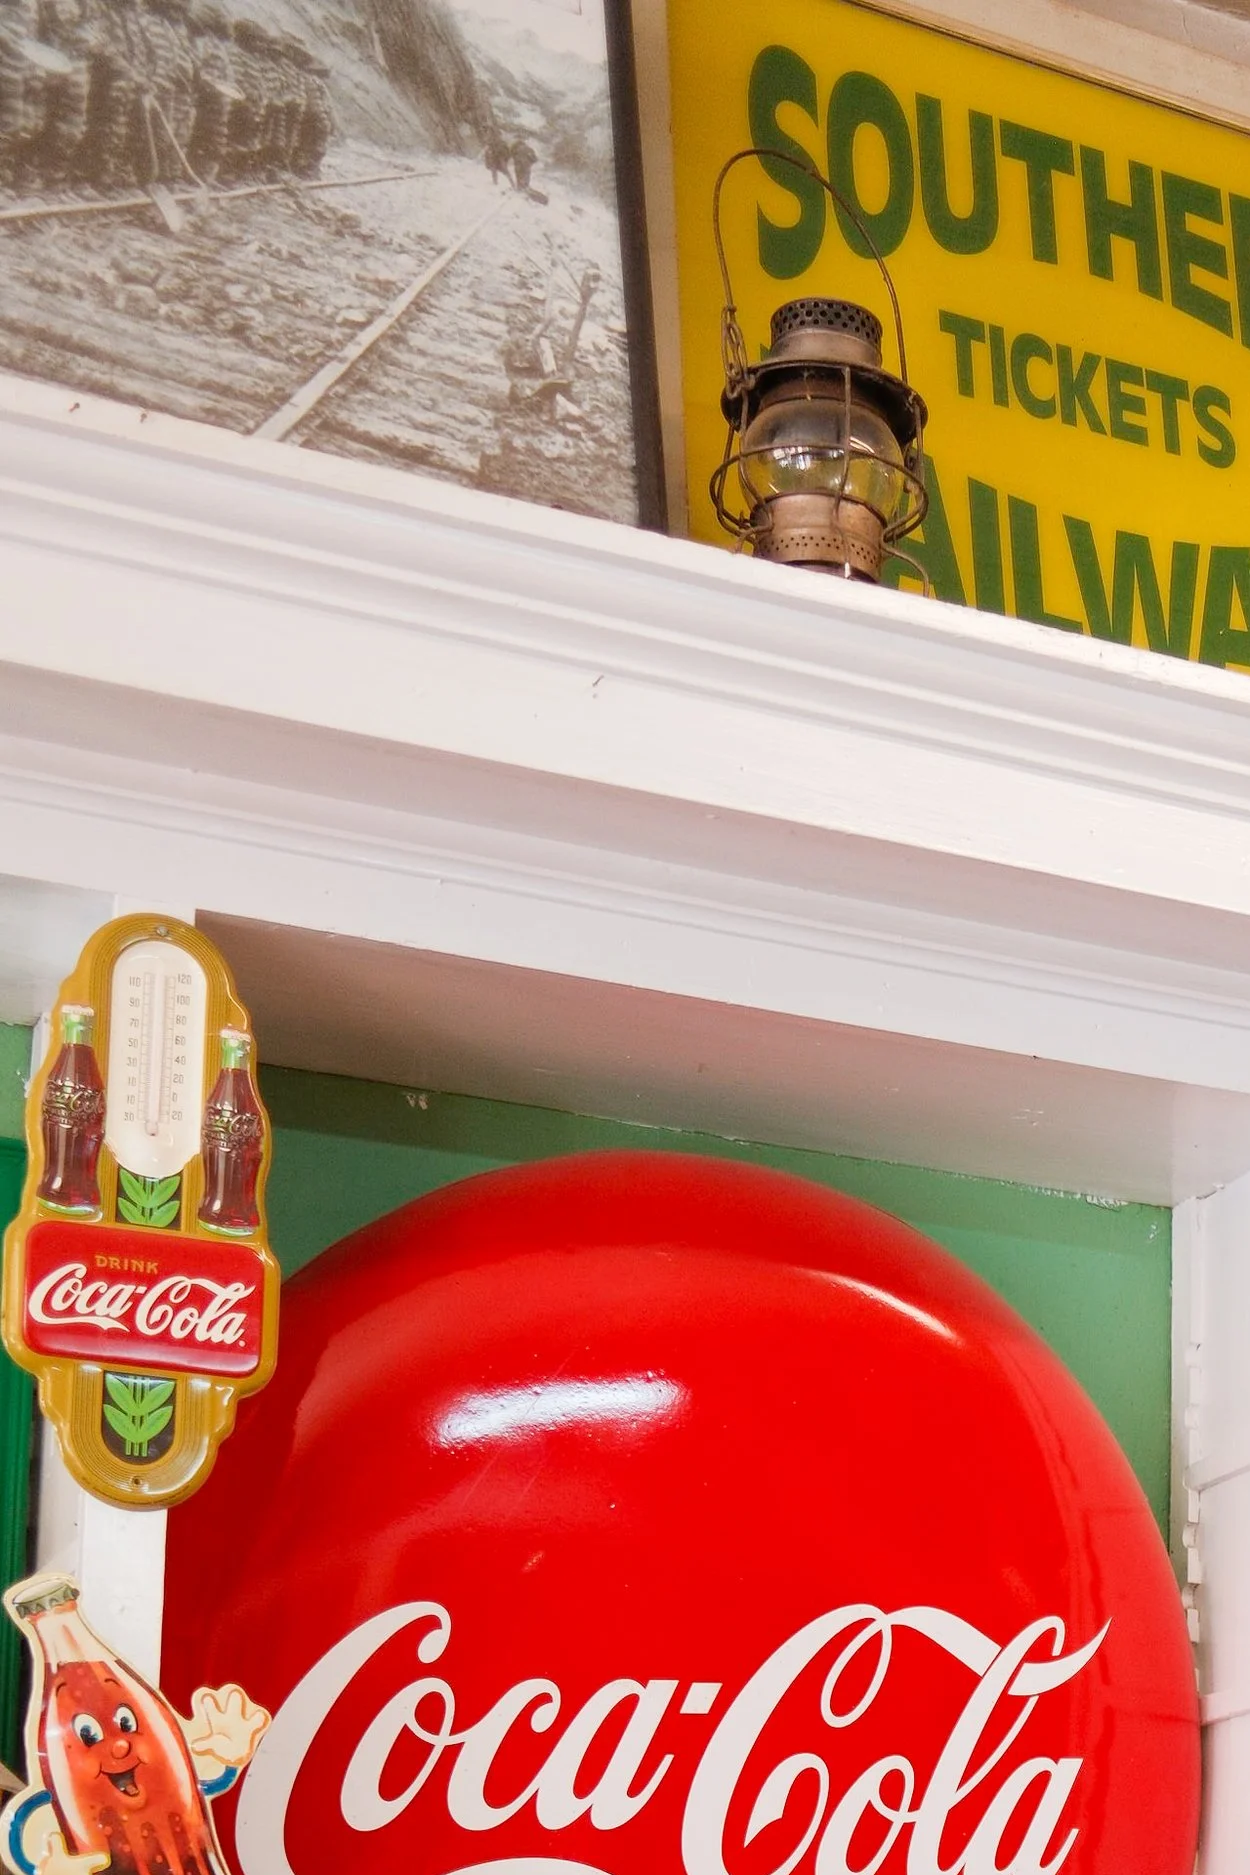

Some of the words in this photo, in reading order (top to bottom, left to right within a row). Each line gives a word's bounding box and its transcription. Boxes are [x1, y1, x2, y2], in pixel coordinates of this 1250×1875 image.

[938, 309, 1238, 469] TICKETS
[28, 1262, 256, 1346] Coca-Cola
[94, 1254, 159, 1275] DRINK
